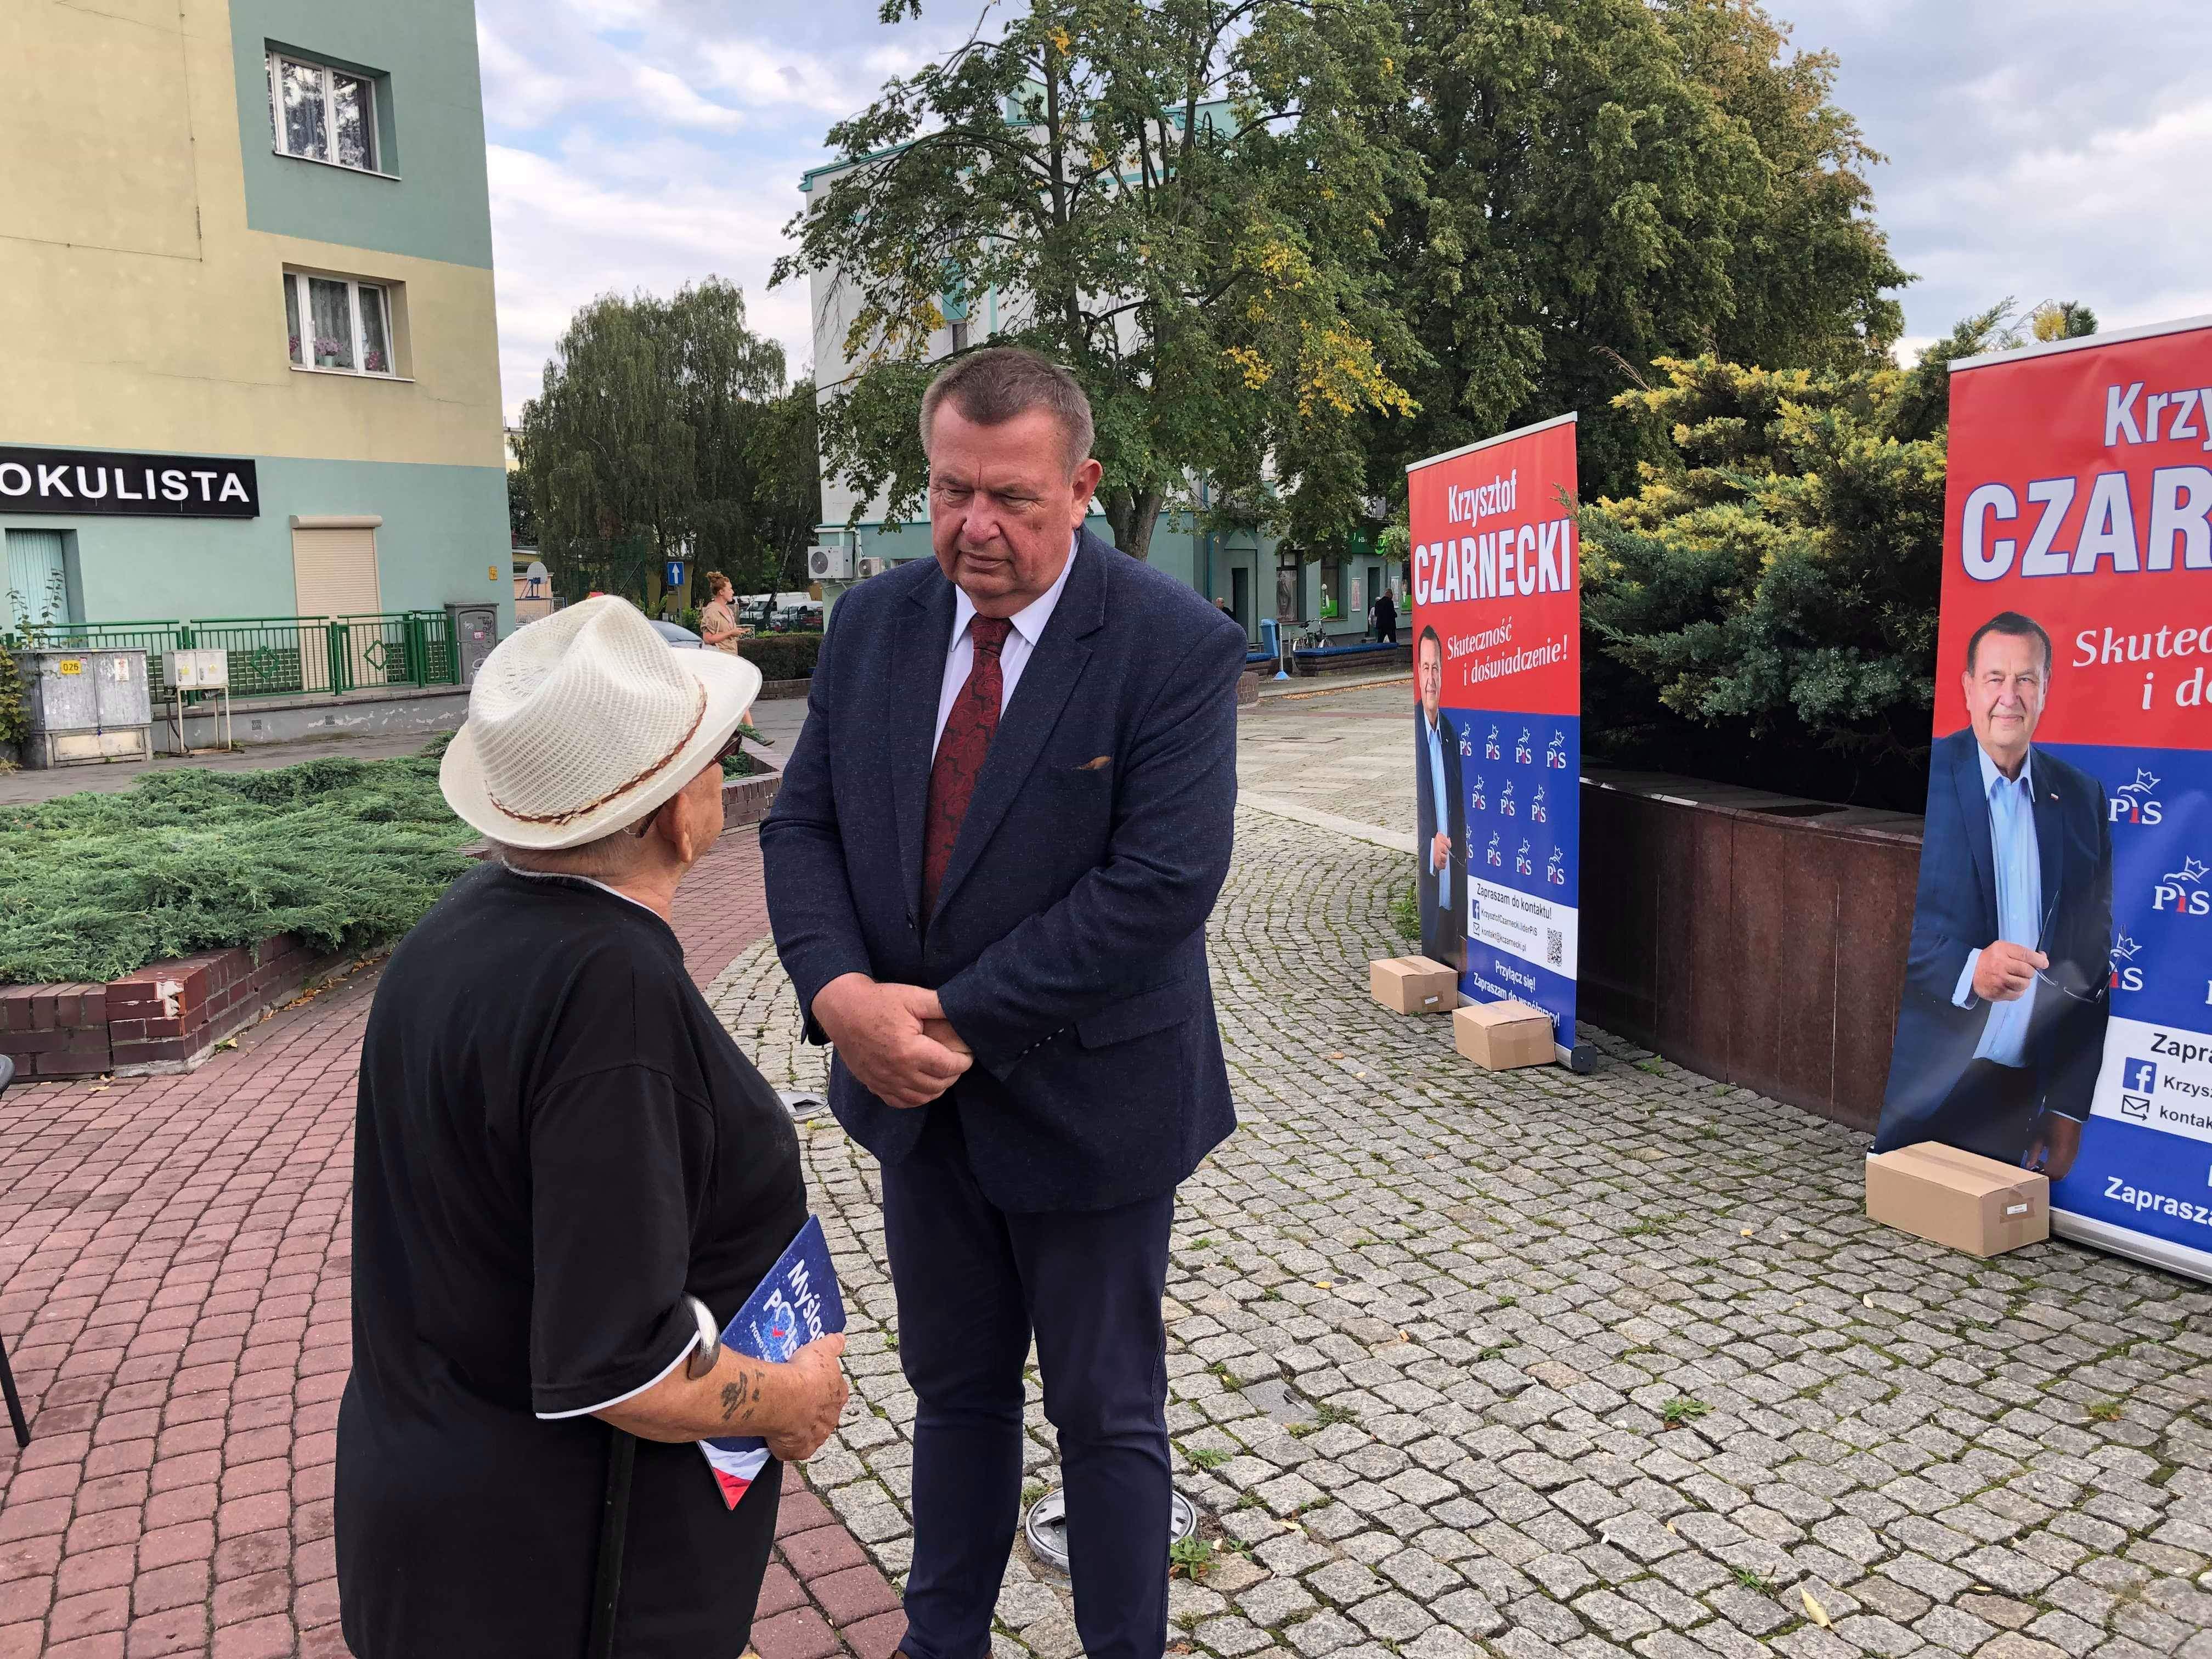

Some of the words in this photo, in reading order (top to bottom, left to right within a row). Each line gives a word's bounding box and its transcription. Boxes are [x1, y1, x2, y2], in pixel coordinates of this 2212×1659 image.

[0, 462, 250, 503] OKULISTA
[1448, 469, 1517, 528] Krzysztof
[1962, 465, 2212, 582] CZAR
[1414, 518, 1571, 606] CZARNECKI
[1447, 616, 1512, 661] Skuteczność
[1463, 662, 1468, 686] i
[2142, 672, 2154, 710] i
[1477, 883, 1510, 905] Zapraszam
[1512, 895, 1520, 909] do
[1521, 898, 1552, 920] kontaktu!
[1474, 972, 1507, 1000] Zapraszam
[1495, 960, 1522, 985] Przyłącz
[1523, 976, 1536, 994] się!
[2164, 1075, 2212, 1097] Krzys
[2104, 1176, 2212, 1227] Zaprasz
[749, 1320, 764, 1348] Prawo
